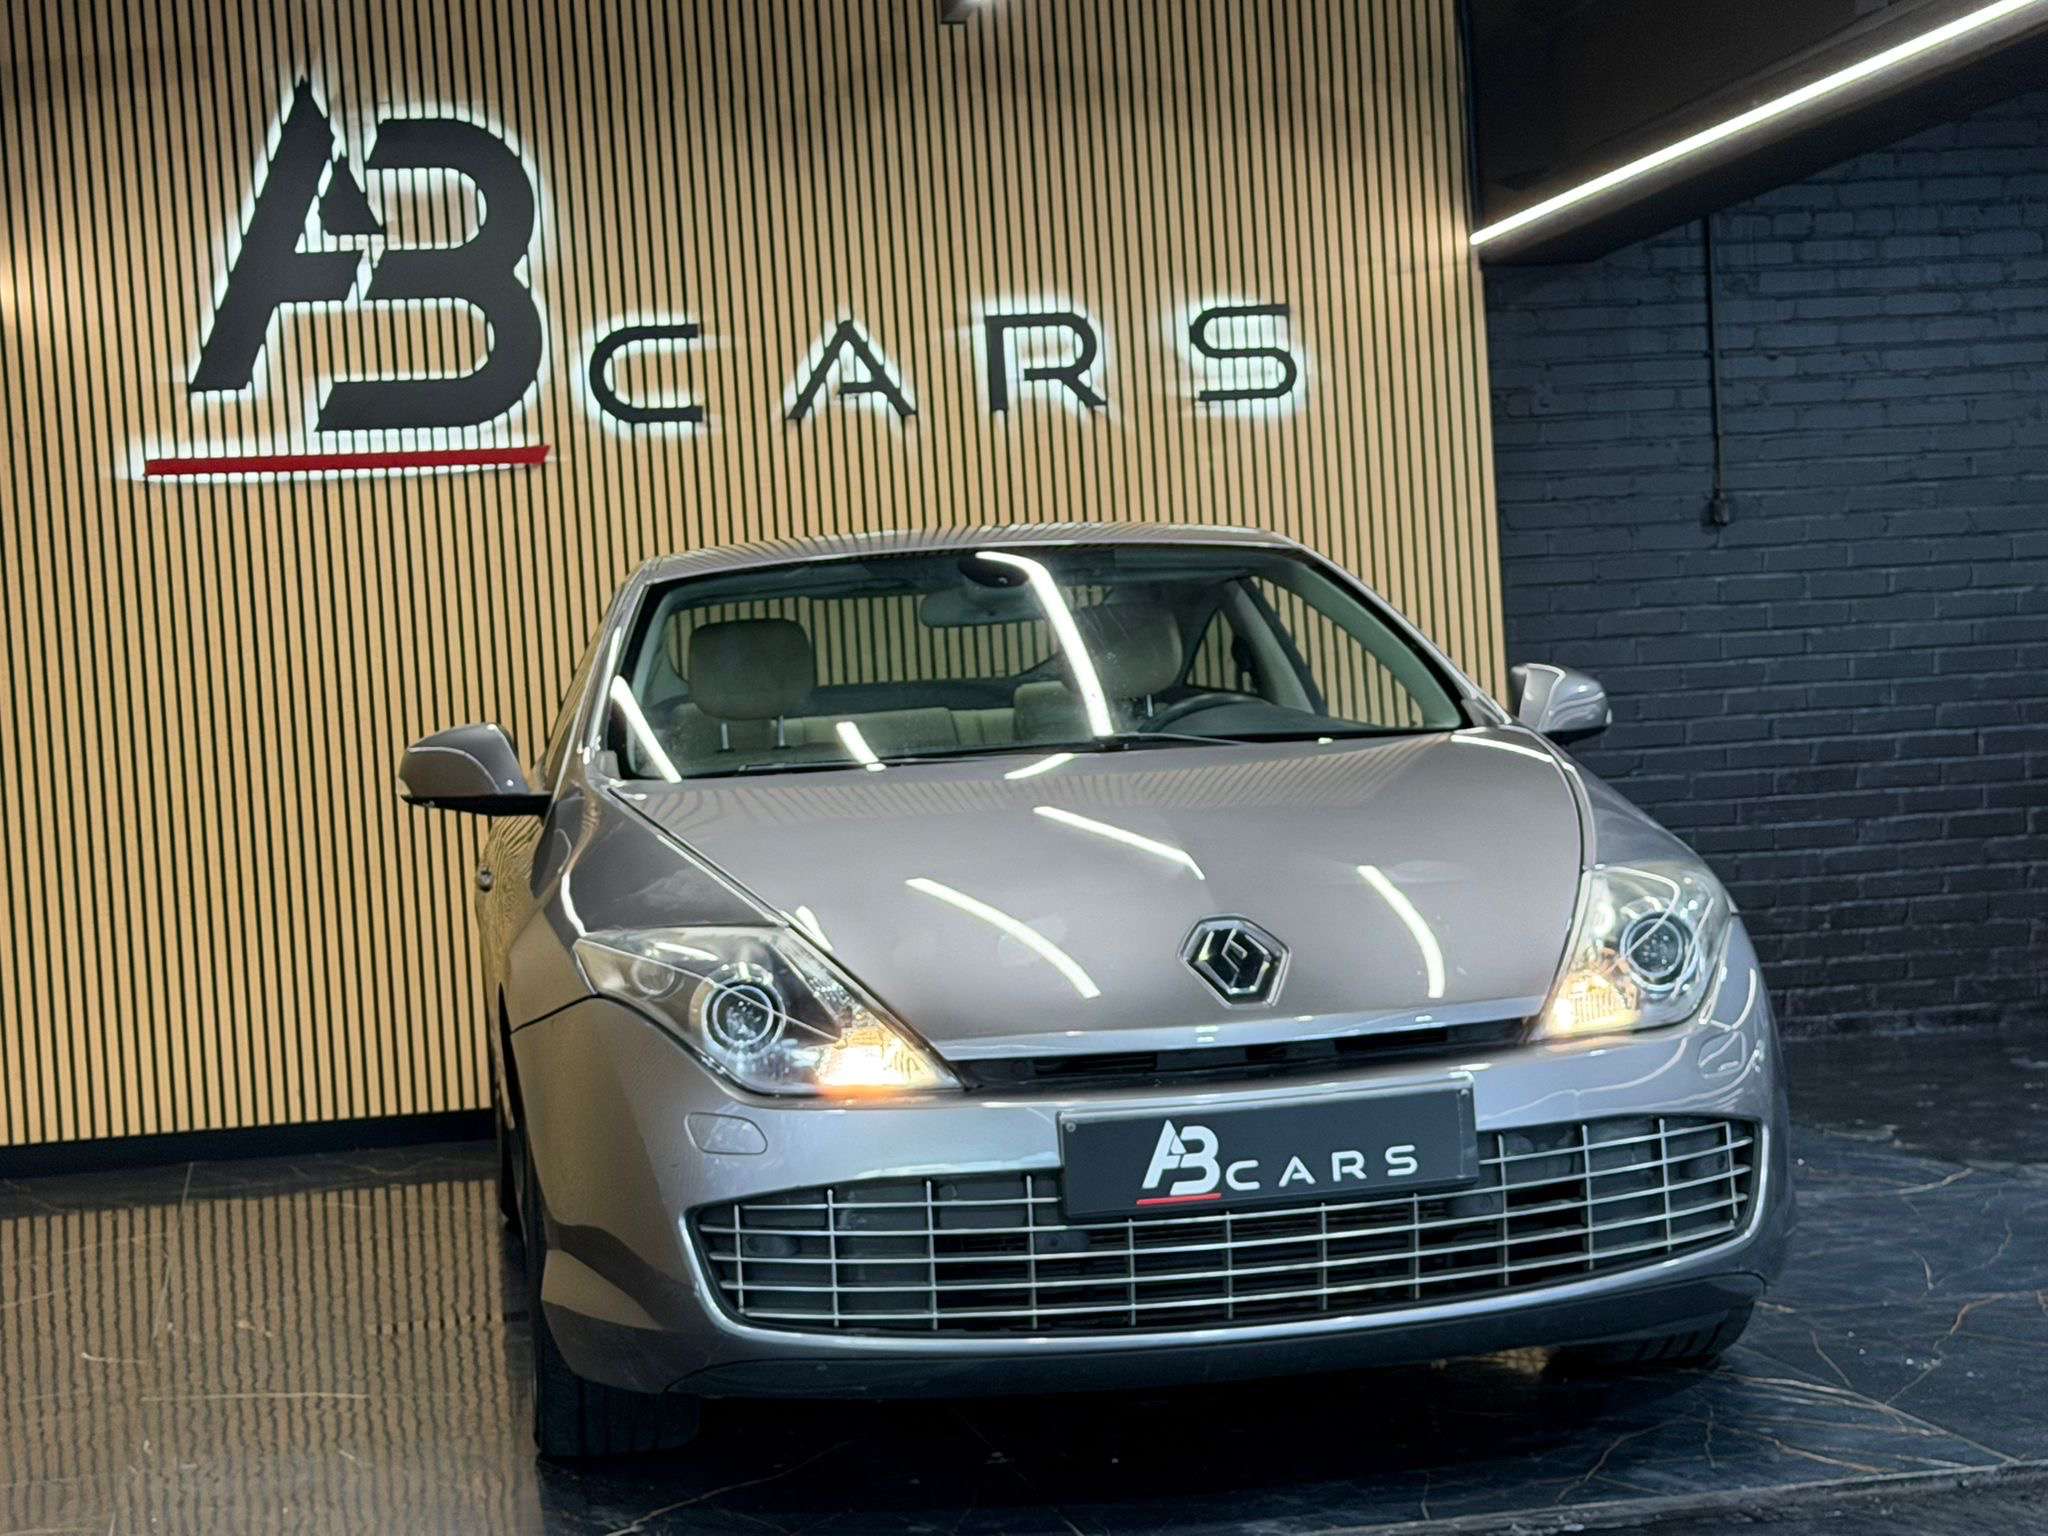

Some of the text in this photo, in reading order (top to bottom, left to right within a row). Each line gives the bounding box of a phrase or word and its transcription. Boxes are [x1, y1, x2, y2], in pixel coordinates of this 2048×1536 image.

[187, 76, 1297, 432] AB CARS
[1141, 1119, 1418, 1196] AB CARS
